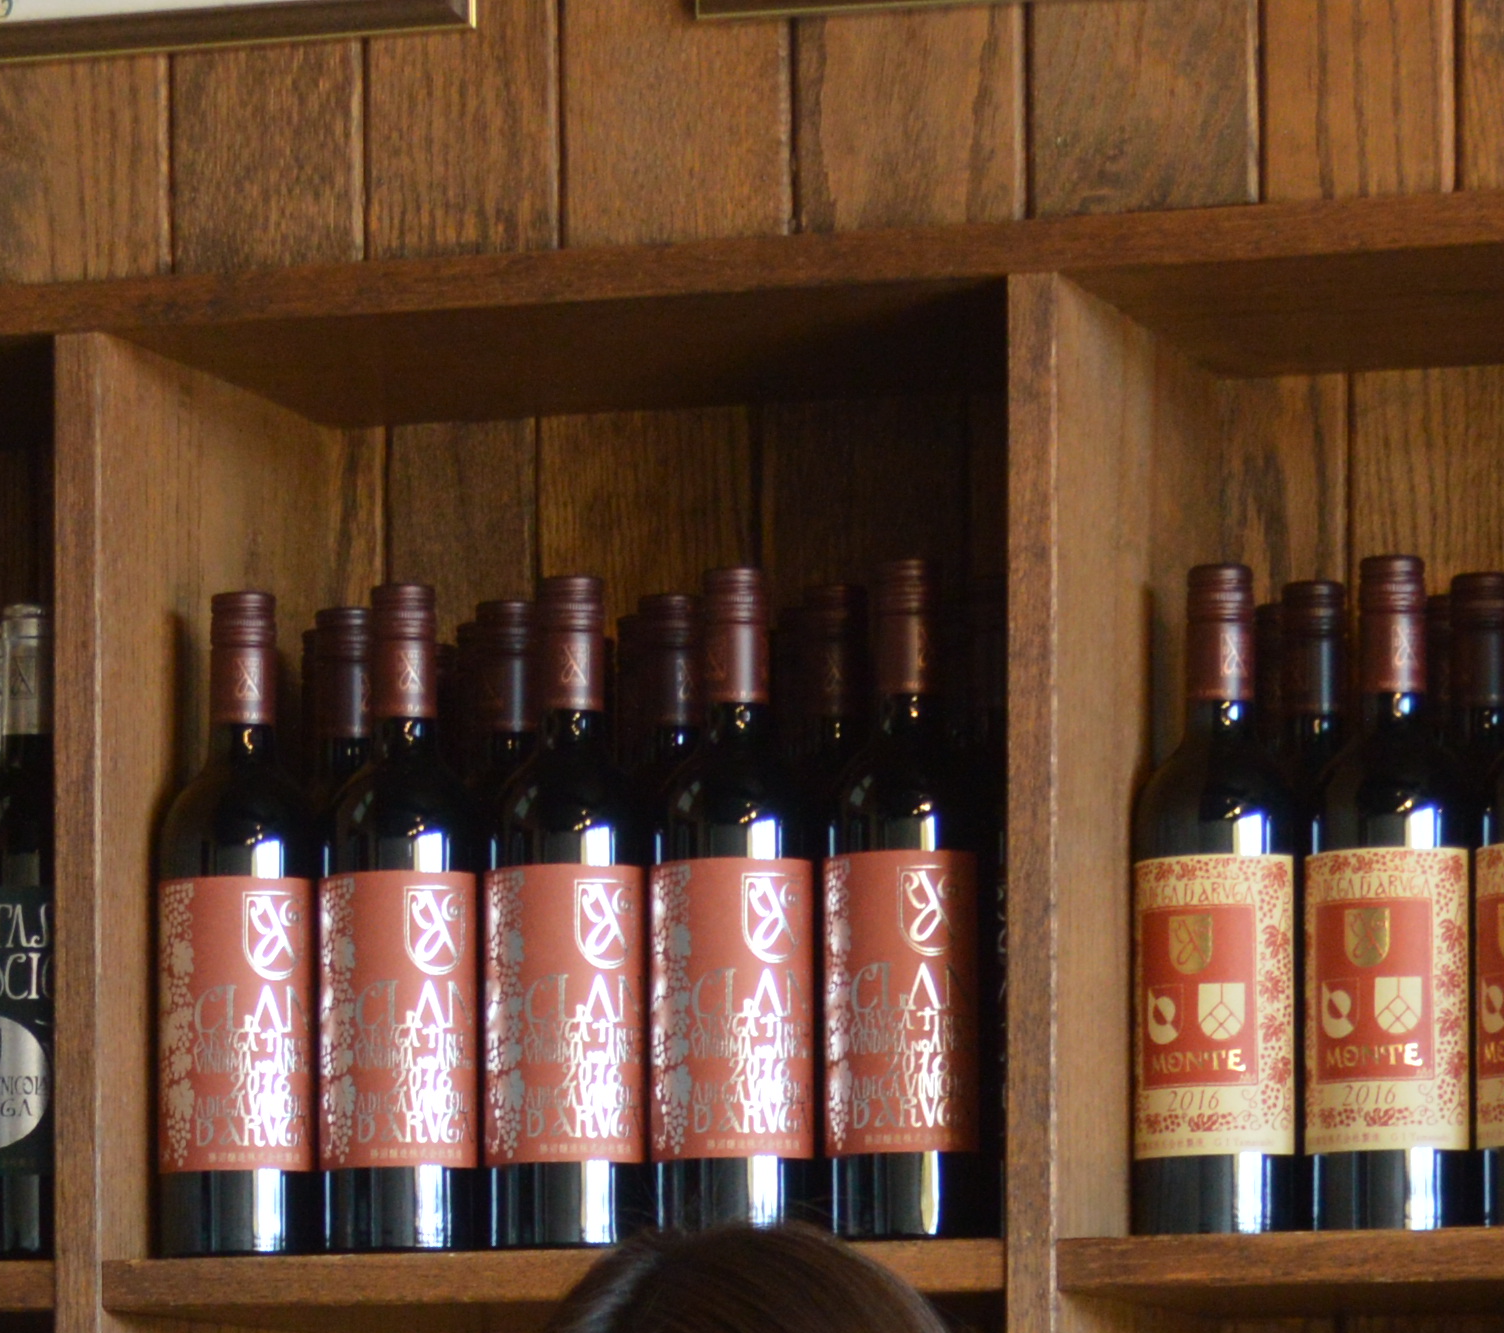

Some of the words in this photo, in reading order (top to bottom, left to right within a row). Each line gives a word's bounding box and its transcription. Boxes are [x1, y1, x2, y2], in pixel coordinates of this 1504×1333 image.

[1150, 1048, 1248, 1075] MONTE
[1326, 1041, 1424, 1069] MONTE
[1166, 1089, 1221, 1112] 2016
[1342, 1083, 1397, 1107] 2016
